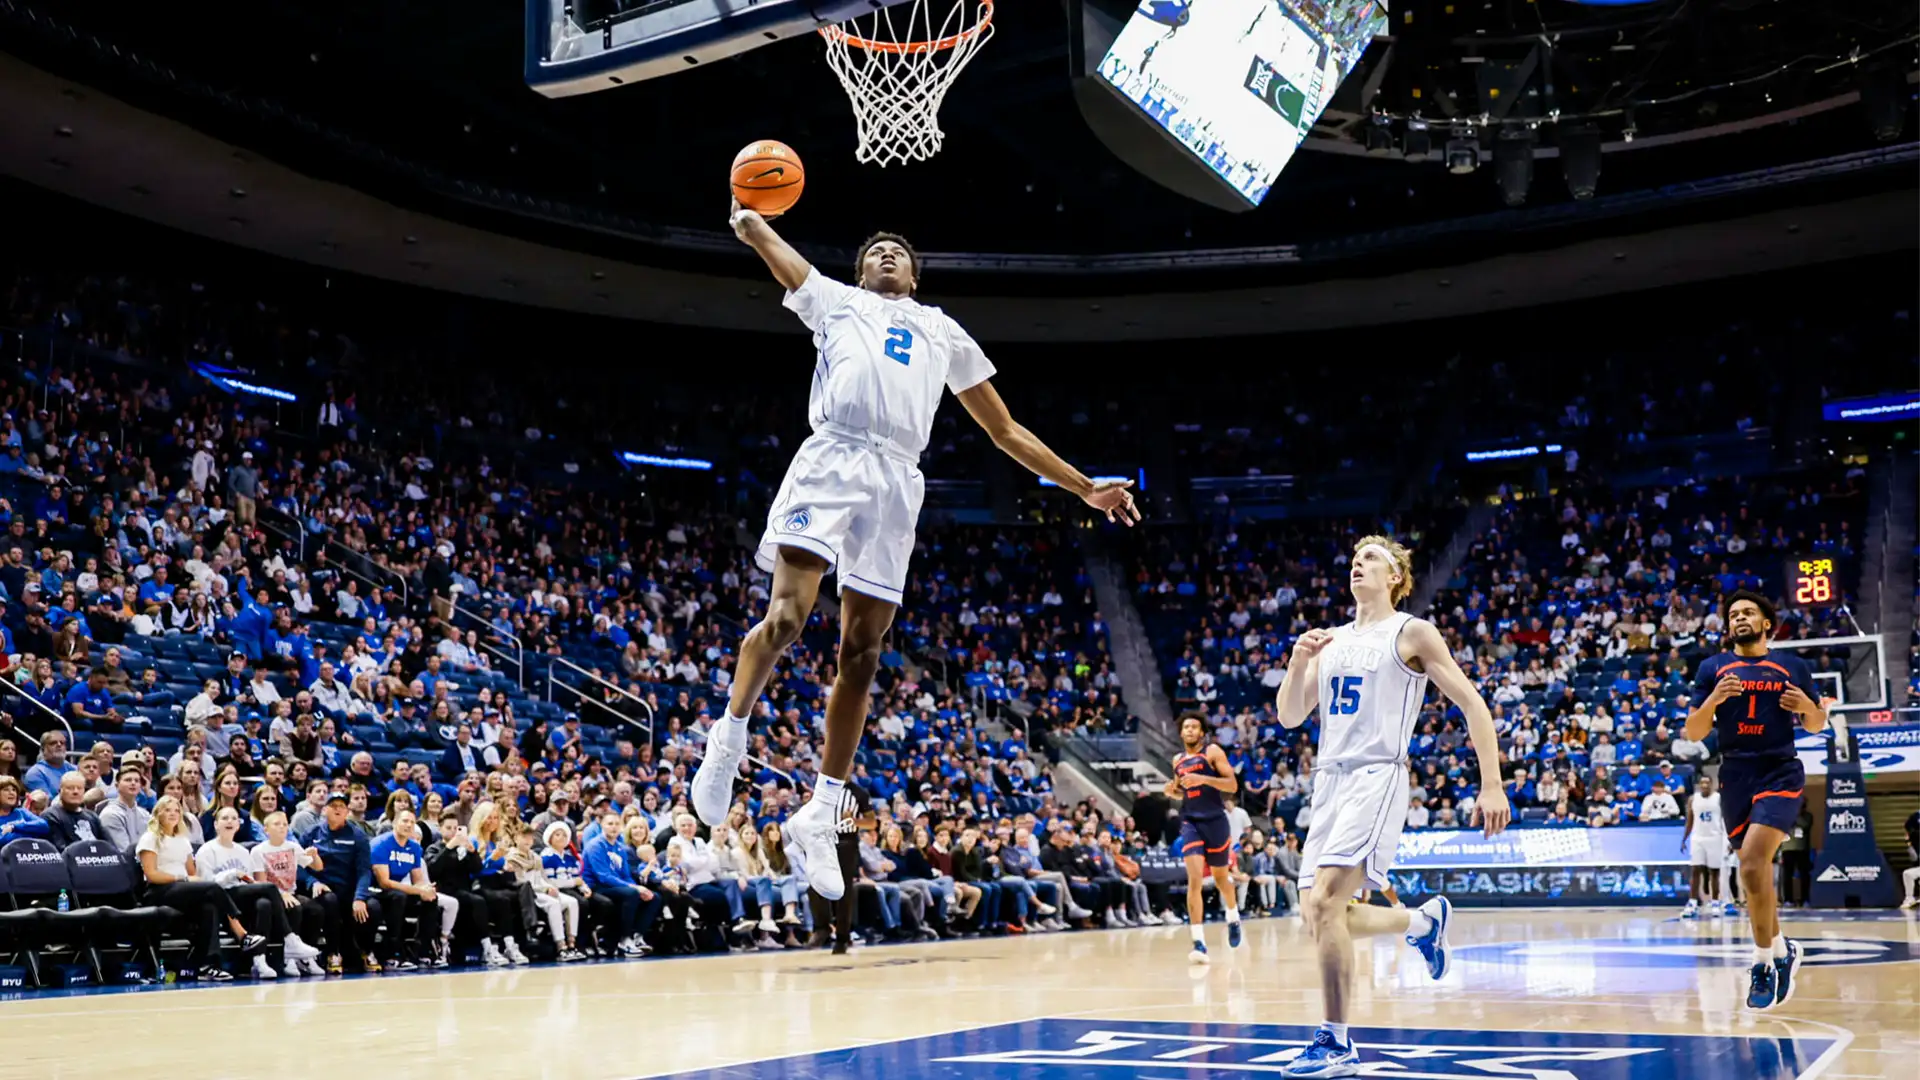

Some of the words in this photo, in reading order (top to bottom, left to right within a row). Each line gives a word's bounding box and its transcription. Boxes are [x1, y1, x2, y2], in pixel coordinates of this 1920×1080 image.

[884, 327, 912, 366] 2
[1799, 559, 1832, 575] 9:39
[1796, 576, 1830, 603] 28
[1740, 681, 1782, 691] ORGAN
[1329, 676, 1363, 715] 15
[1747, 694, 1756, 719] 1
[1700, 811, 1712, 822] 45
[16, 853, 62, 862] SAPPHIRE
[75, 855, 120, 864] SAPPHIRE
[2, 978, 22, 987] BYU
